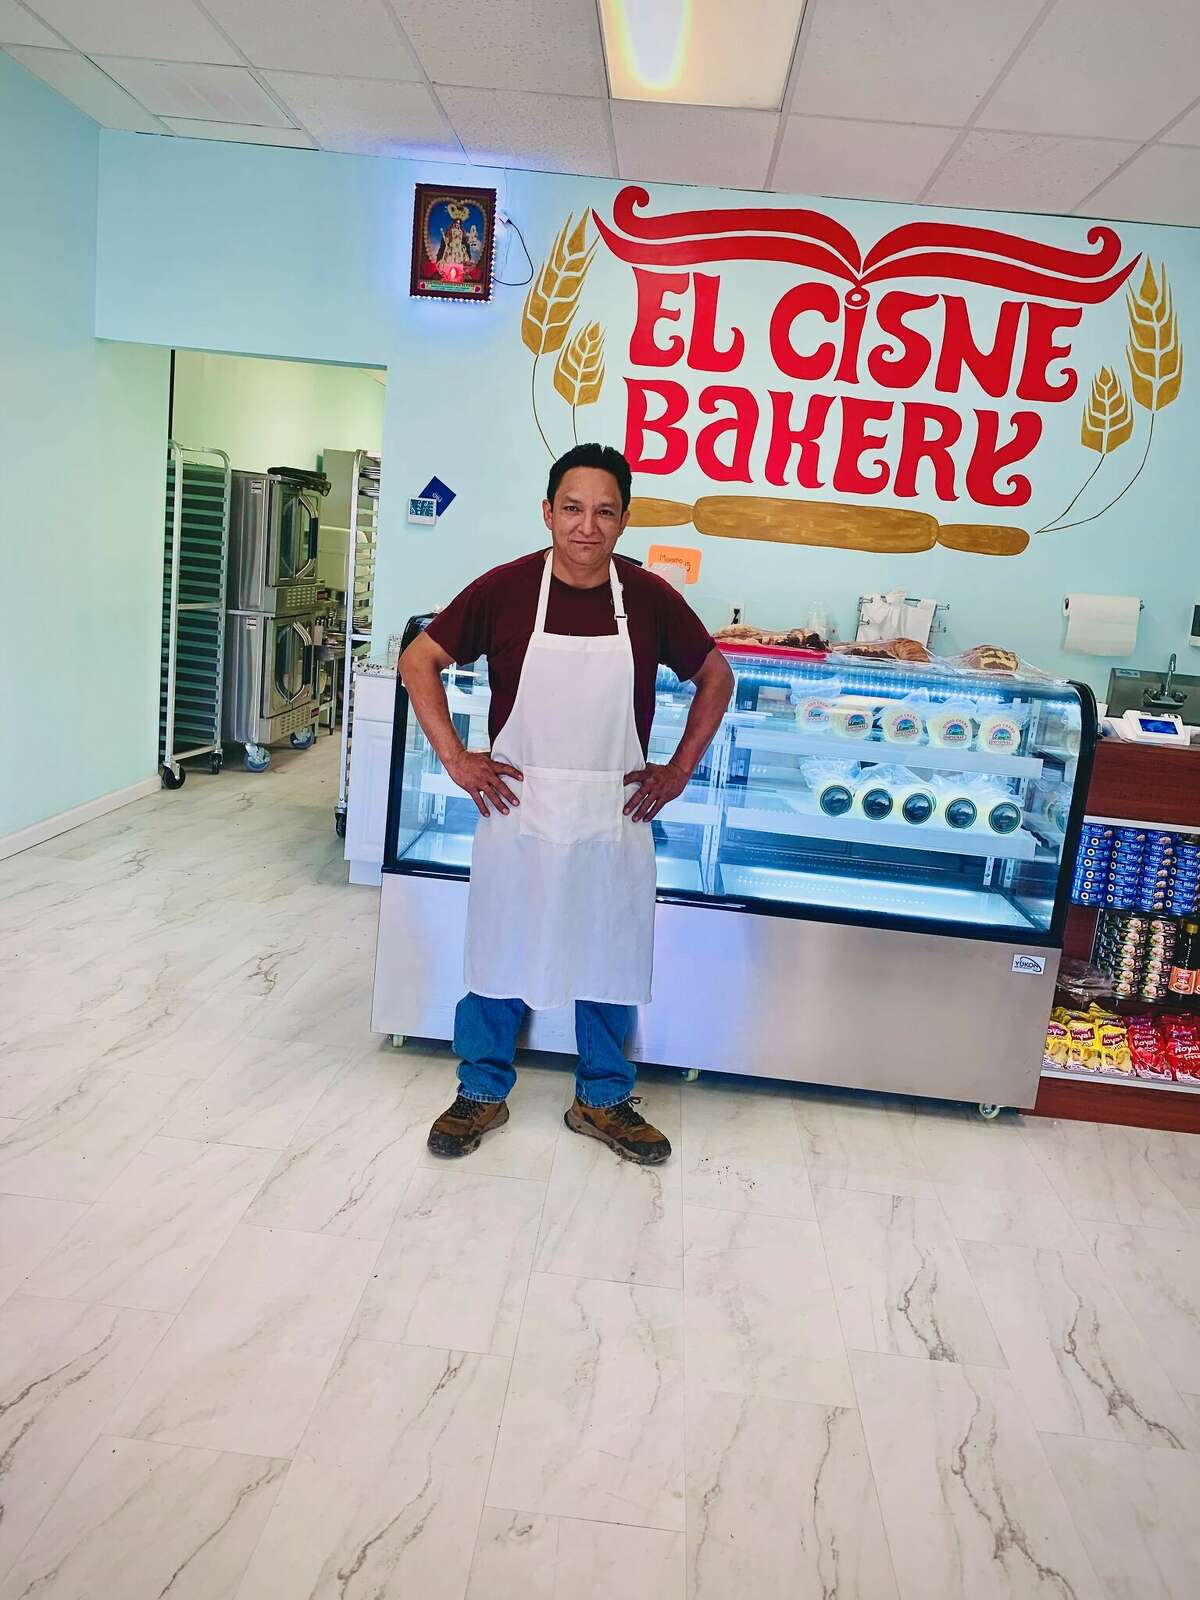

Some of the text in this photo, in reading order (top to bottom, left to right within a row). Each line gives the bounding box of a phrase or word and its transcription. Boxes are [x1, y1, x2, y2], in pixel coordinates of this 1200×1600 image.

[628, 267, 745, 372] EL
[1015, 960, 1039, 969] YUKON
[1175, 1044, 1199, 1054] Royal
